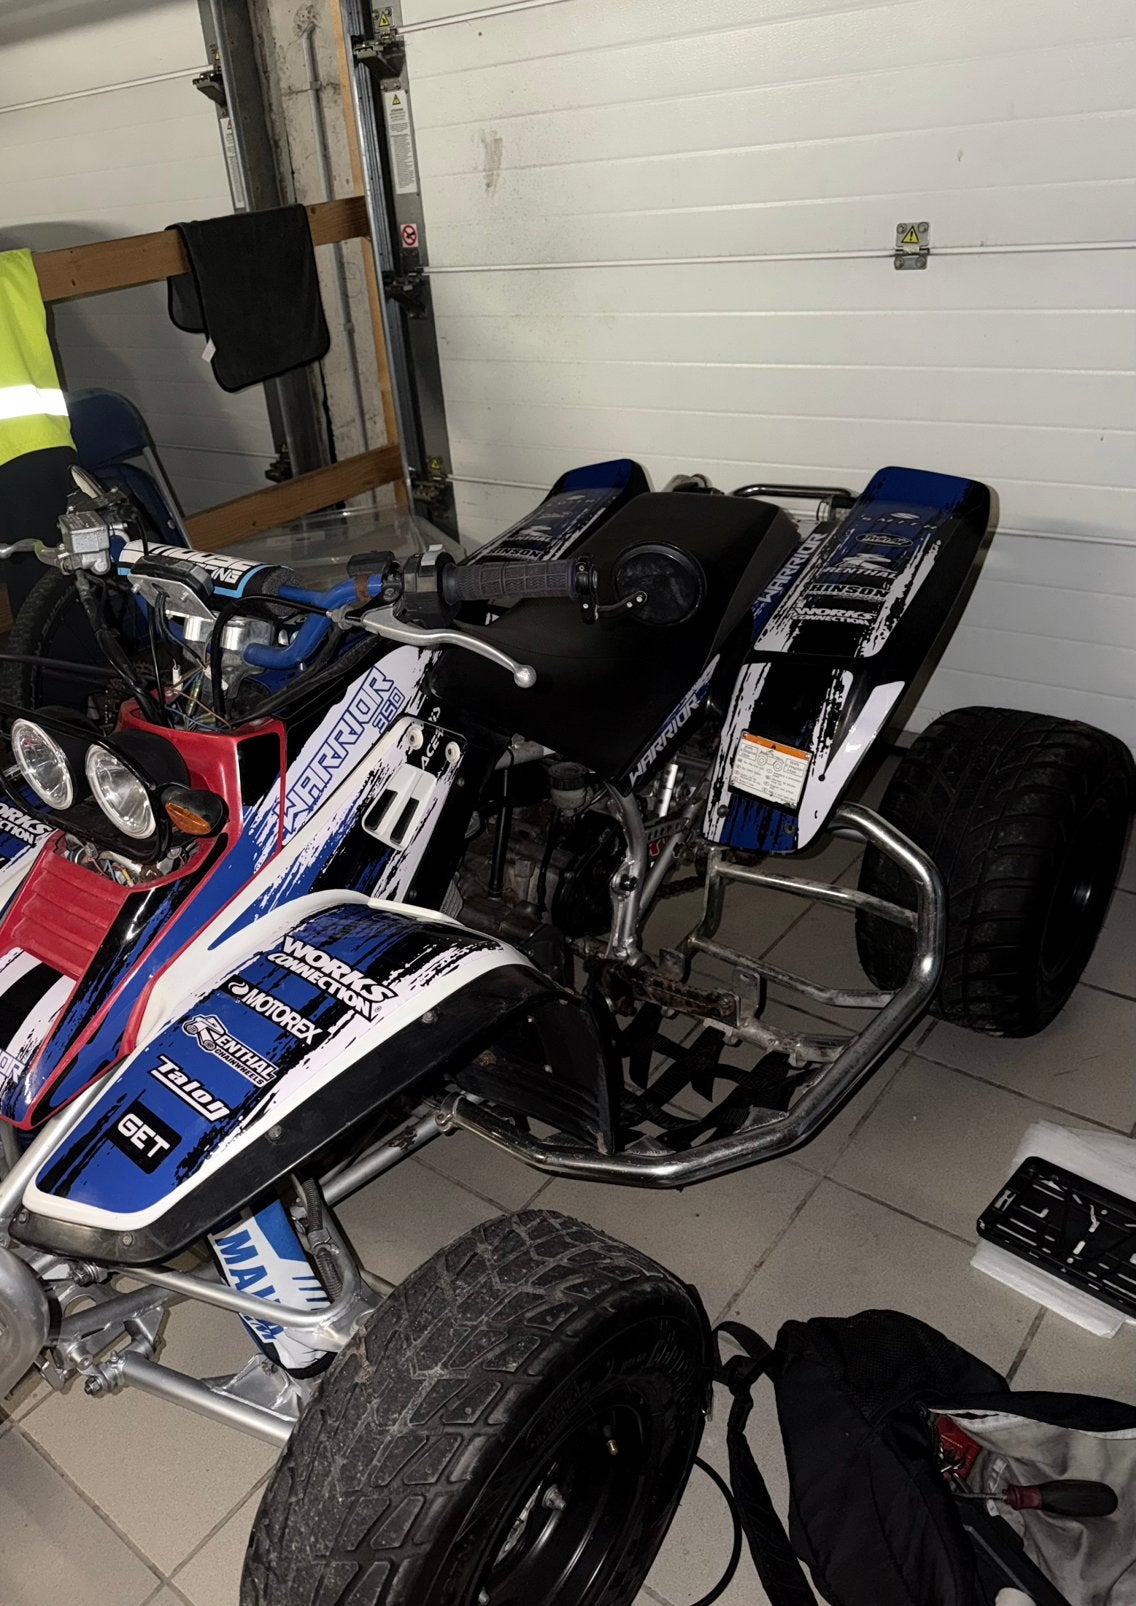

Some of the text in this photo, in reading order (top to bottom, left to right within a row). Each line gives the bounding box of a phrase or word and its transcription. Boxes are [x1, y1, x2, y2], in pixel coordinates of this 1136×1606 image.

[758, 532, 829, 605] WARRIOR
[808, 583, 890, 599] HINSON
[823, 566, 898, 580] RENTHAL
[792, 615, 871, 626] CONNECTION
[794, 606, 879, 620] WORKS
[272, 665, 395, 835] WARRIOR
[628, 692, 701, 789] WARRIOR
[0, 801, 53, 836] ORKS
[267, 953, 374, 1016] CONNECTION
[284, 935, 398, 1004] WORKS
[242, 988, 324, 1046] MOTOREX
[213, 1048, 265, 1086] CHAINWHEELS
[117, 1112, 171, 1158] GET
